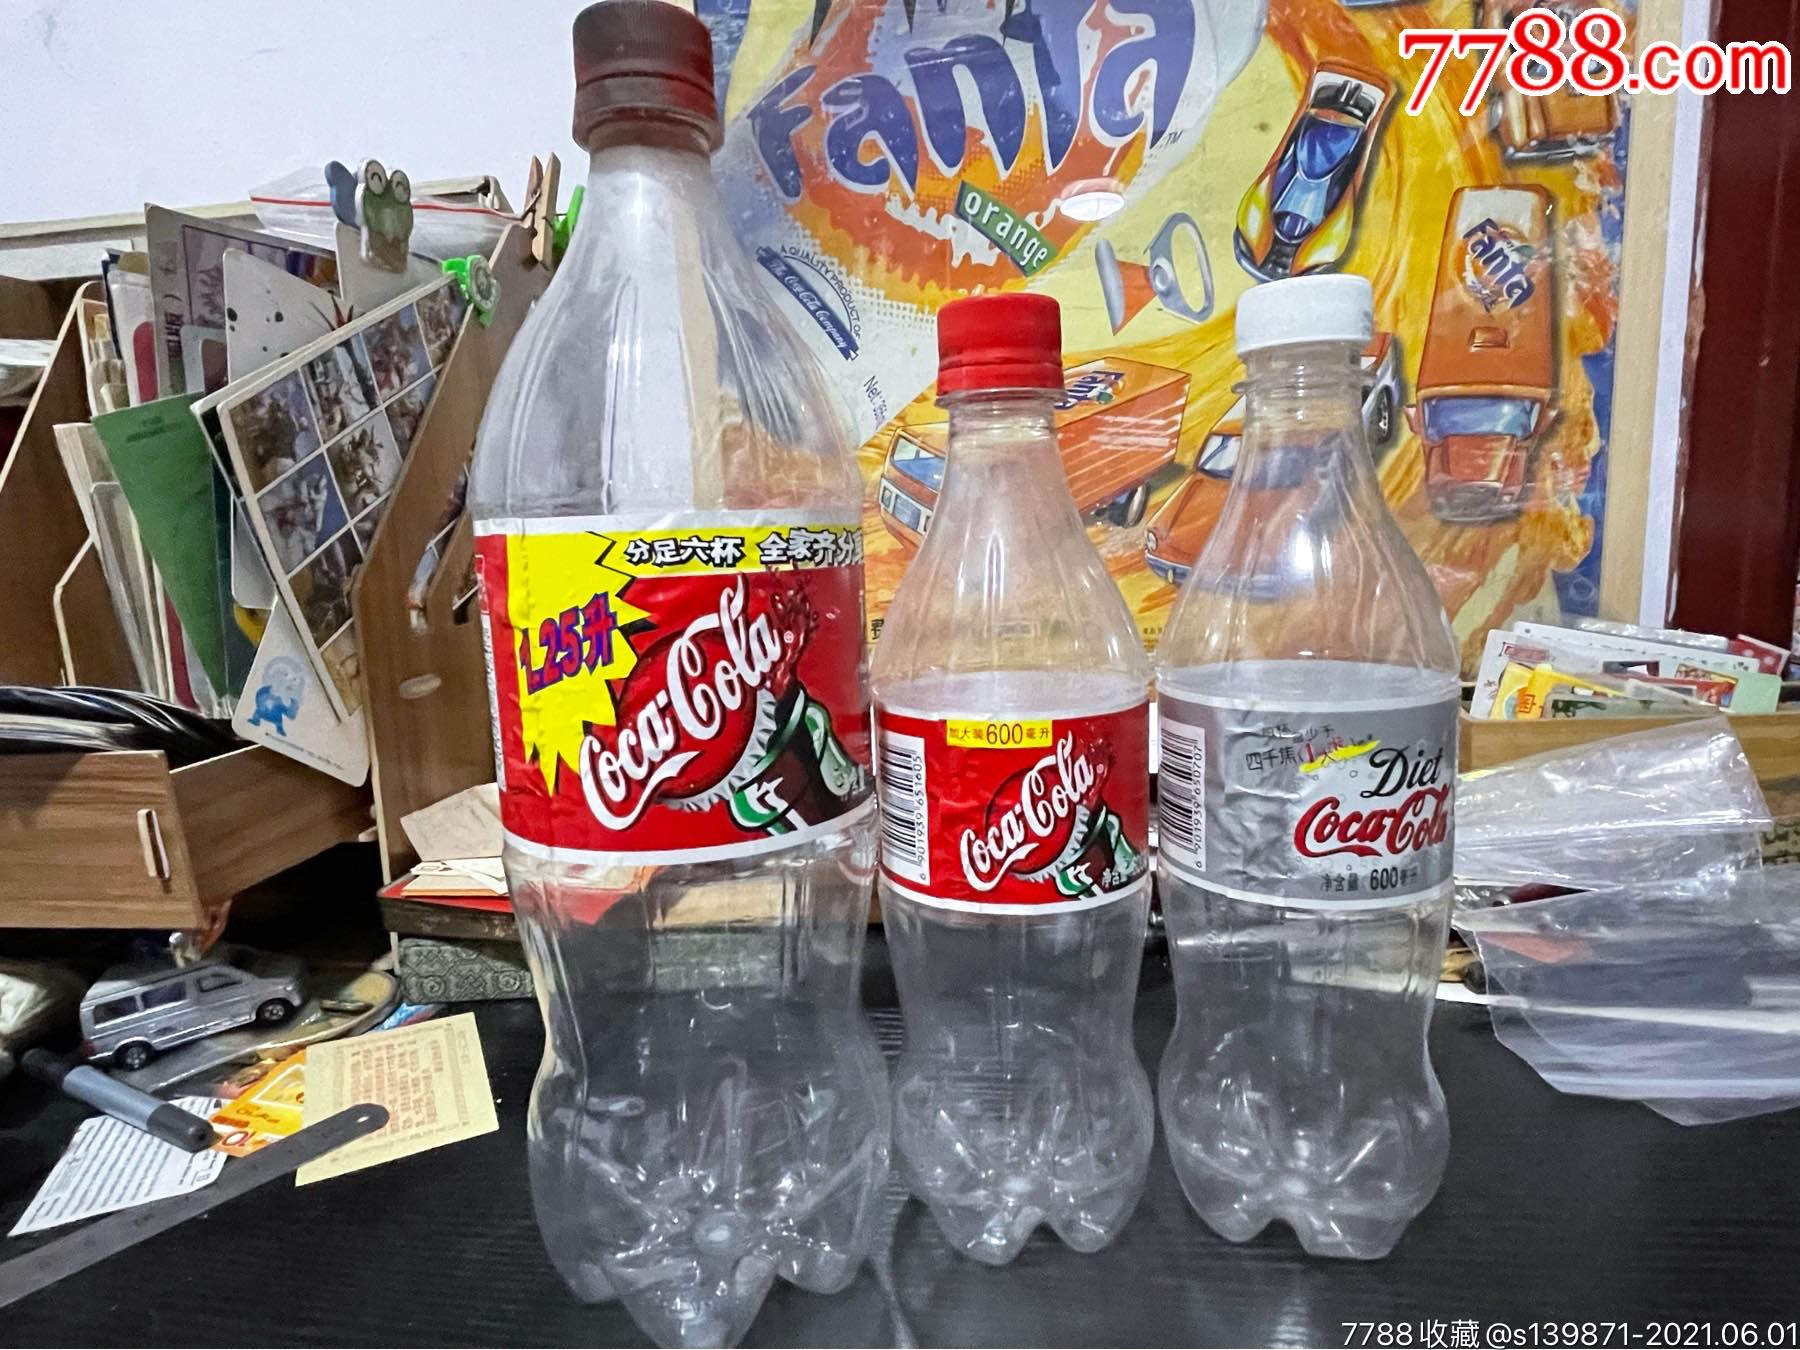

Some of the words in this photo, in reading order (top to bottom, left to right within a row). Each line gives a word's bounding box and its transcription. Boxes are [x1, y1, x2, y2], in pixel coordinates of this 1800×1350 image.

[748, 0, 1196, 199] Fanta
[965, 190, 1050, 269] orange
[1462, 217, 1536, 310] Fanta
[789, 246, 833, 275] QUALITY
[830, 270, 861, 322] PRODUCT
[815, 310, 849, 349] Company
[625, 535, 746, 568] 分足六杯
[518, 590, 618, 696] 1.25升
[578, 573, 783, 831] Coca-Cola
[959, 729, 1095, 892] Coca-Cola
[1359, 744, 1444, 799] Diet
[1293, 782, 1451, 859] Coca-Cola
